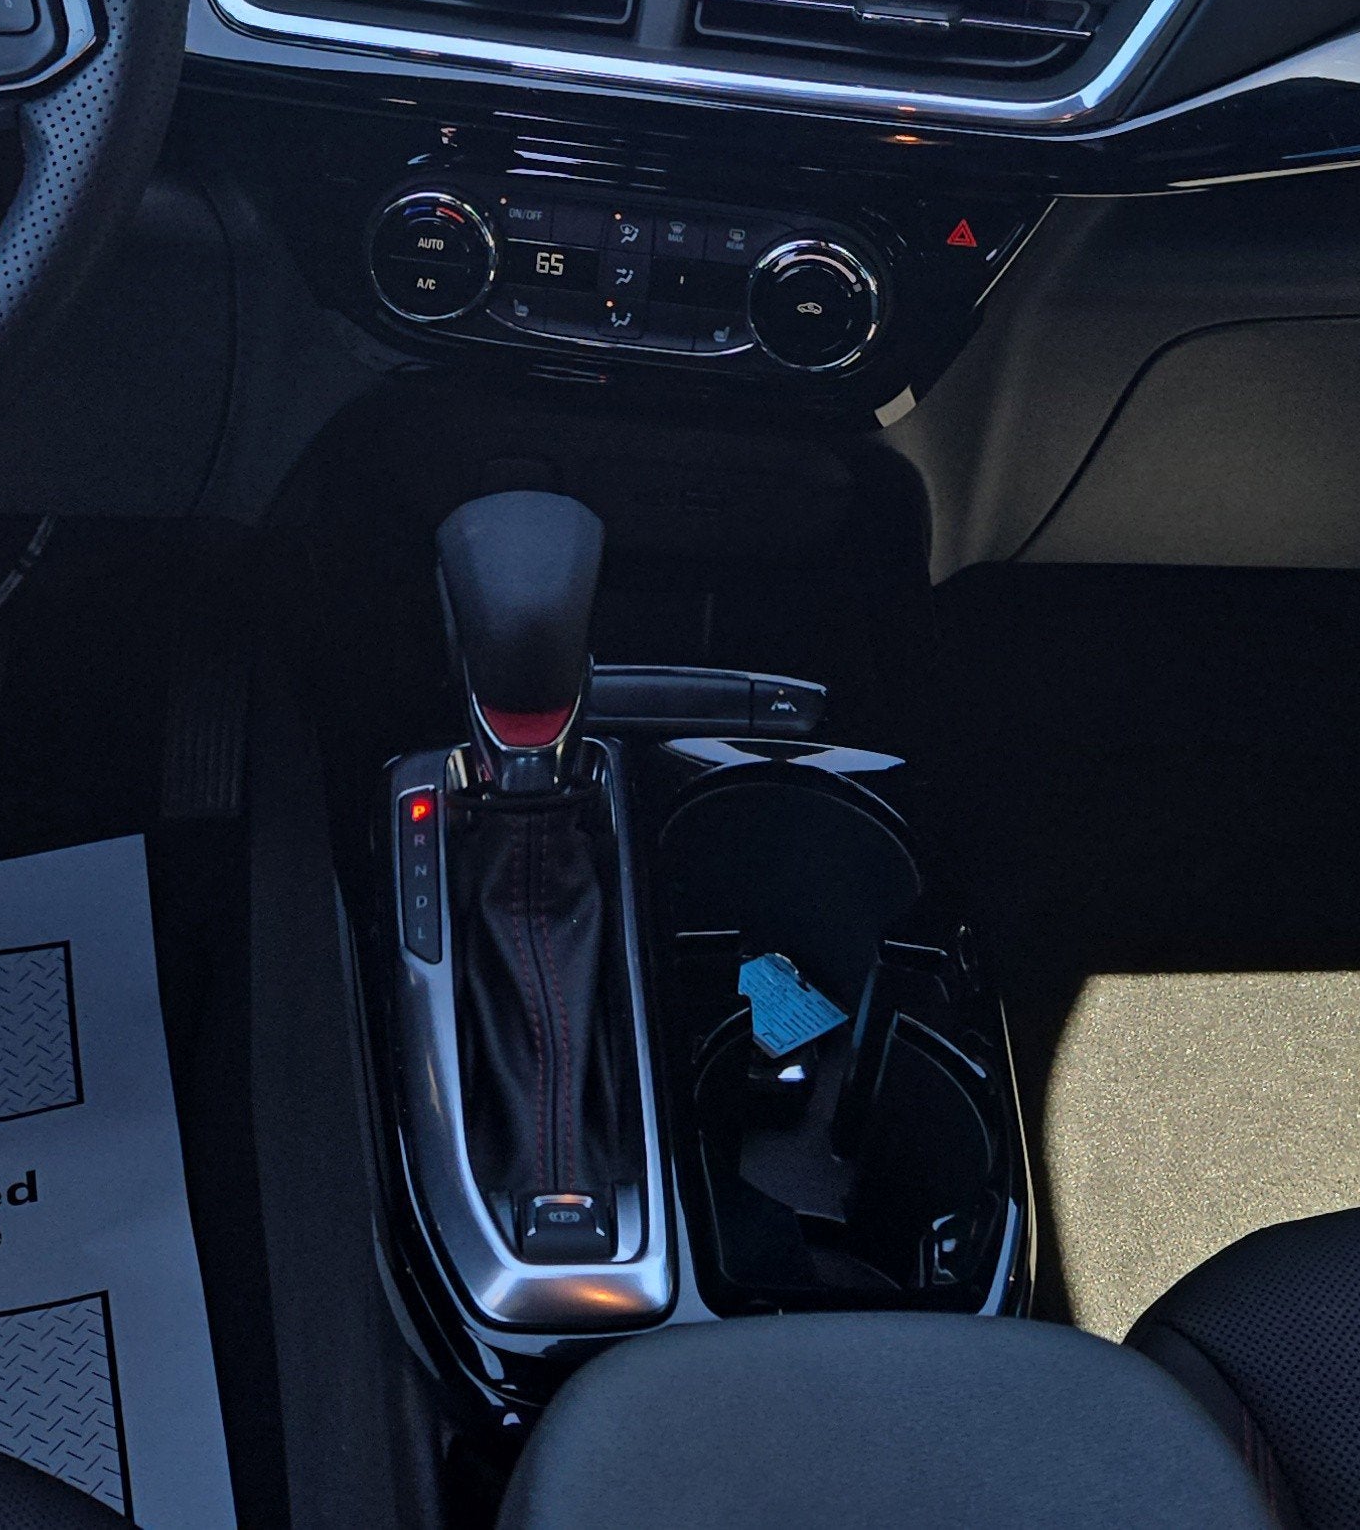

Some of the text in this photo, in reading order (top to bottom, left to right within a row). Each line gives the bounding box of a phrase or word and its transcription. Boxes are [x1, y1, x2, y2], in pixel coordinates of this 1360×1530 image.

[509, 208, 543, 220] ON/OFF
[417, 237, 444, 251] AUTO
[536, 252, 565, 276] 65
[417, 278, 436, 290] A/C
[412, 805, 426, 819] P
[414, 834, 426, 847] R
[414, 865, 427, 878] N
[416, 895, 428, 909] D
